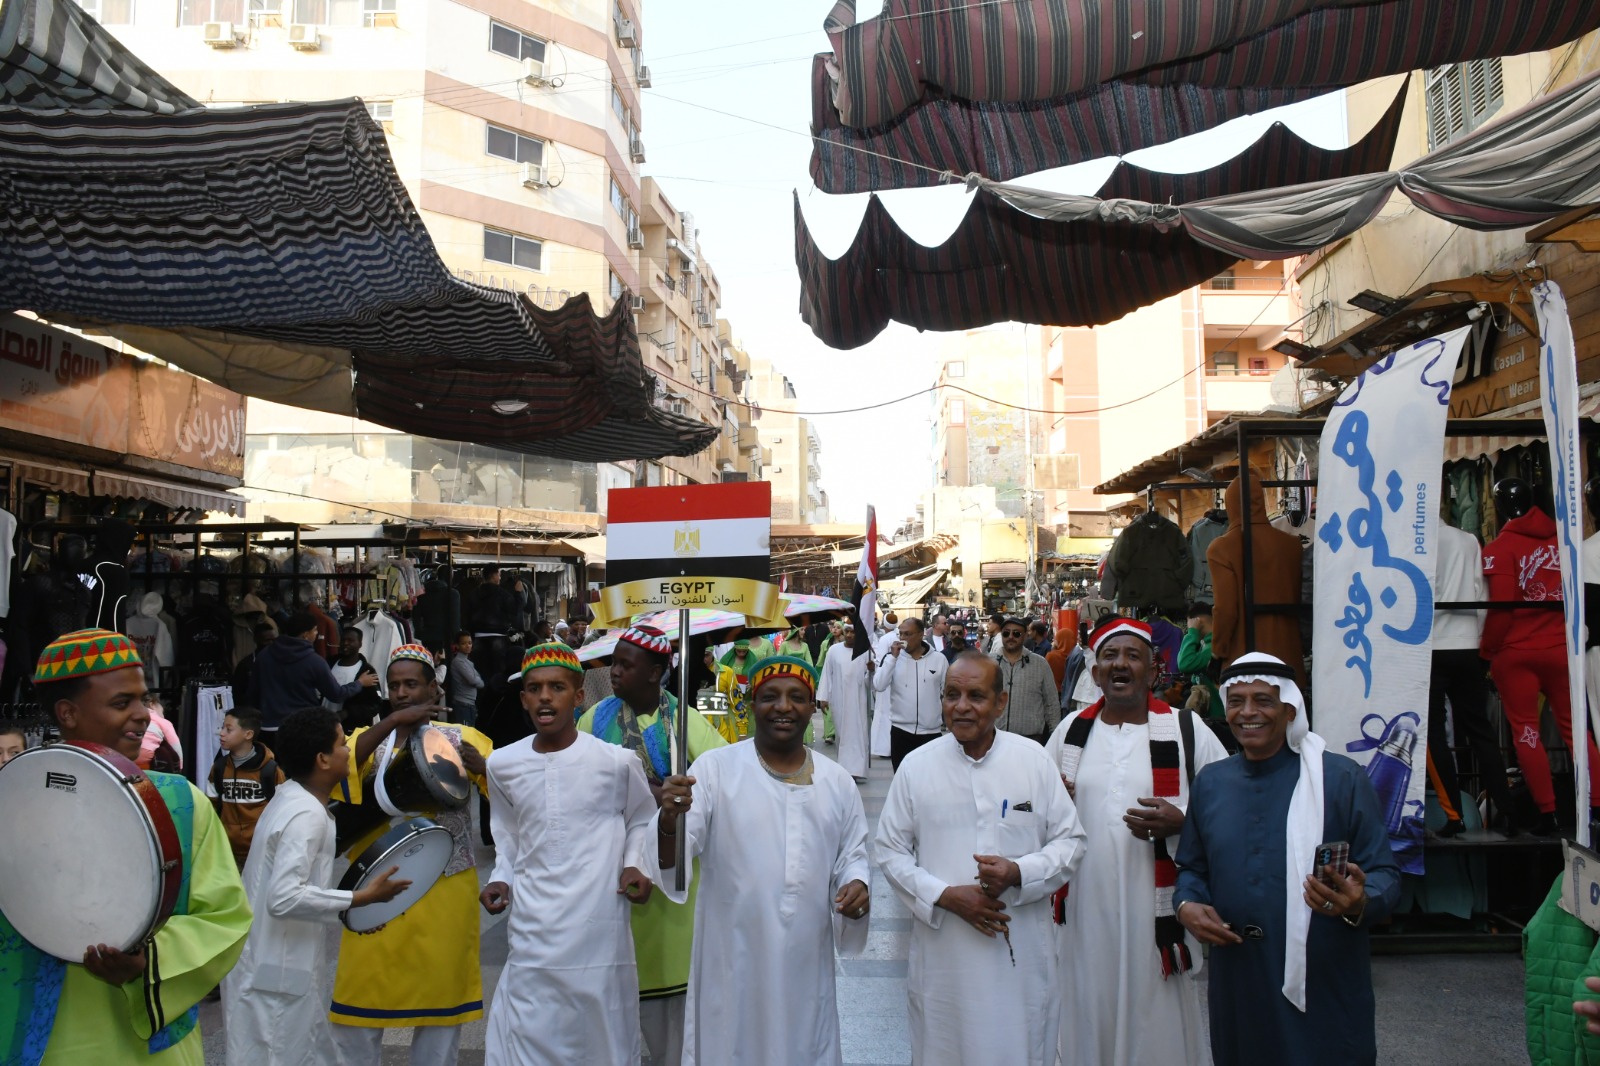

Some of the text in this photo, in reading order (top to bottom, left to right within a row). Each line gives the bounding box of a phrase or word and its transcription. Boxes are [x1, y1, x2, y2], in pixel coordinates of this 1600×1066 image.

[1494, 346, 1525, 371] Casual
[1508, 380, 1535, 399] Wear
[1411, 482, 1427, 555] perfumes
[660, 582, 715, 594] EGYPT
[625, 594, 744, 607] اسوان للفنون الشعبية
[1334, 571, 1373, 700] عطور
[223, 787, 265, 800] EARS
